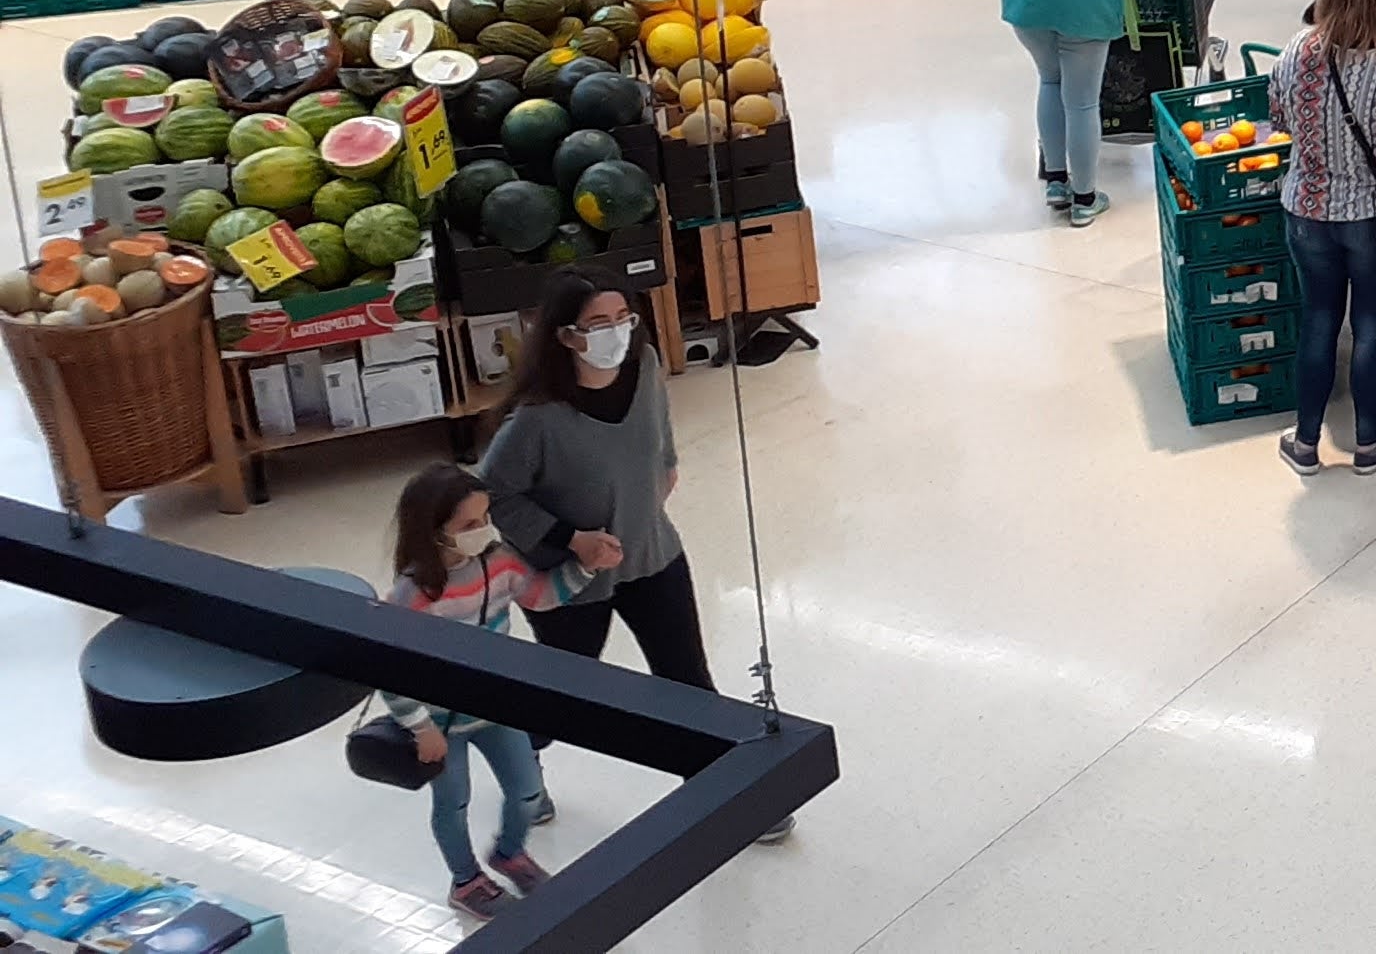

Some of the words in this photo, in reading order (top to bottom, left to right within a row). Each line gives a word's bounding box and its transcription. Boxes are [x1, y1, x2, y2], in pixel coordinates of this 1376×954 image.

[418, 129, 447, 171] 1,69
[43, 197, 87, 227] 2,49
[291, 314, 367, 338] WATERMELON
